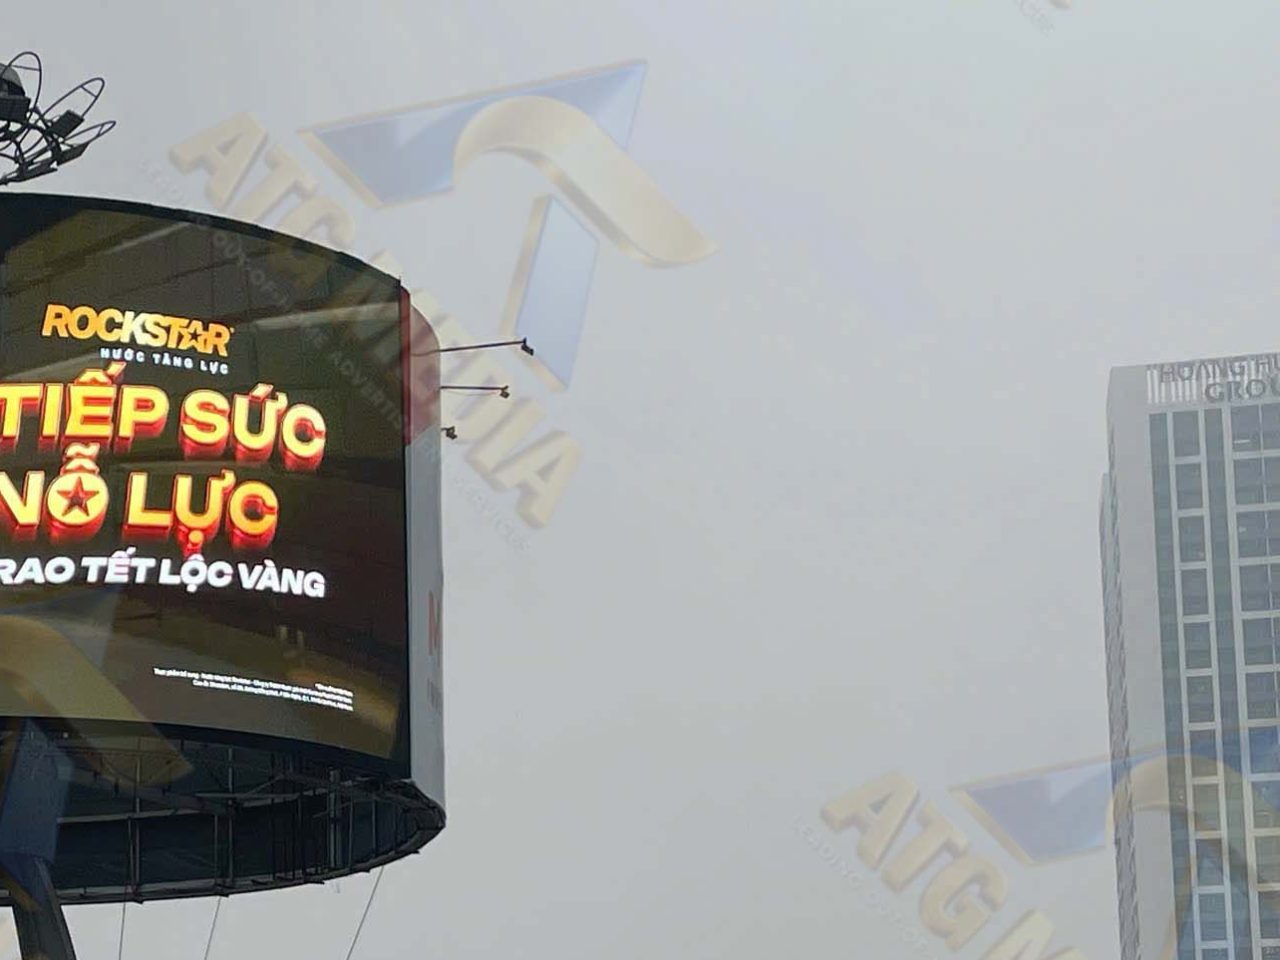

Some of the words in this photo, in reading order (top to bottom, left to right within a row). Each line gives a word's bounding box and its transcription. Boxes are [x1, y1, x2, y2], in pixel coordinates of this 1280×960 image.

[42, 304, 231, 357] ROCKSTAR
[181, 383, 326, 466] SỨC
[124, 469, 279, 549] LỰC
[80, 547, 156, 583] TẾT
[158, 553, 234, 593] LỘC
[237, 560, 325, 598] VÀNG
